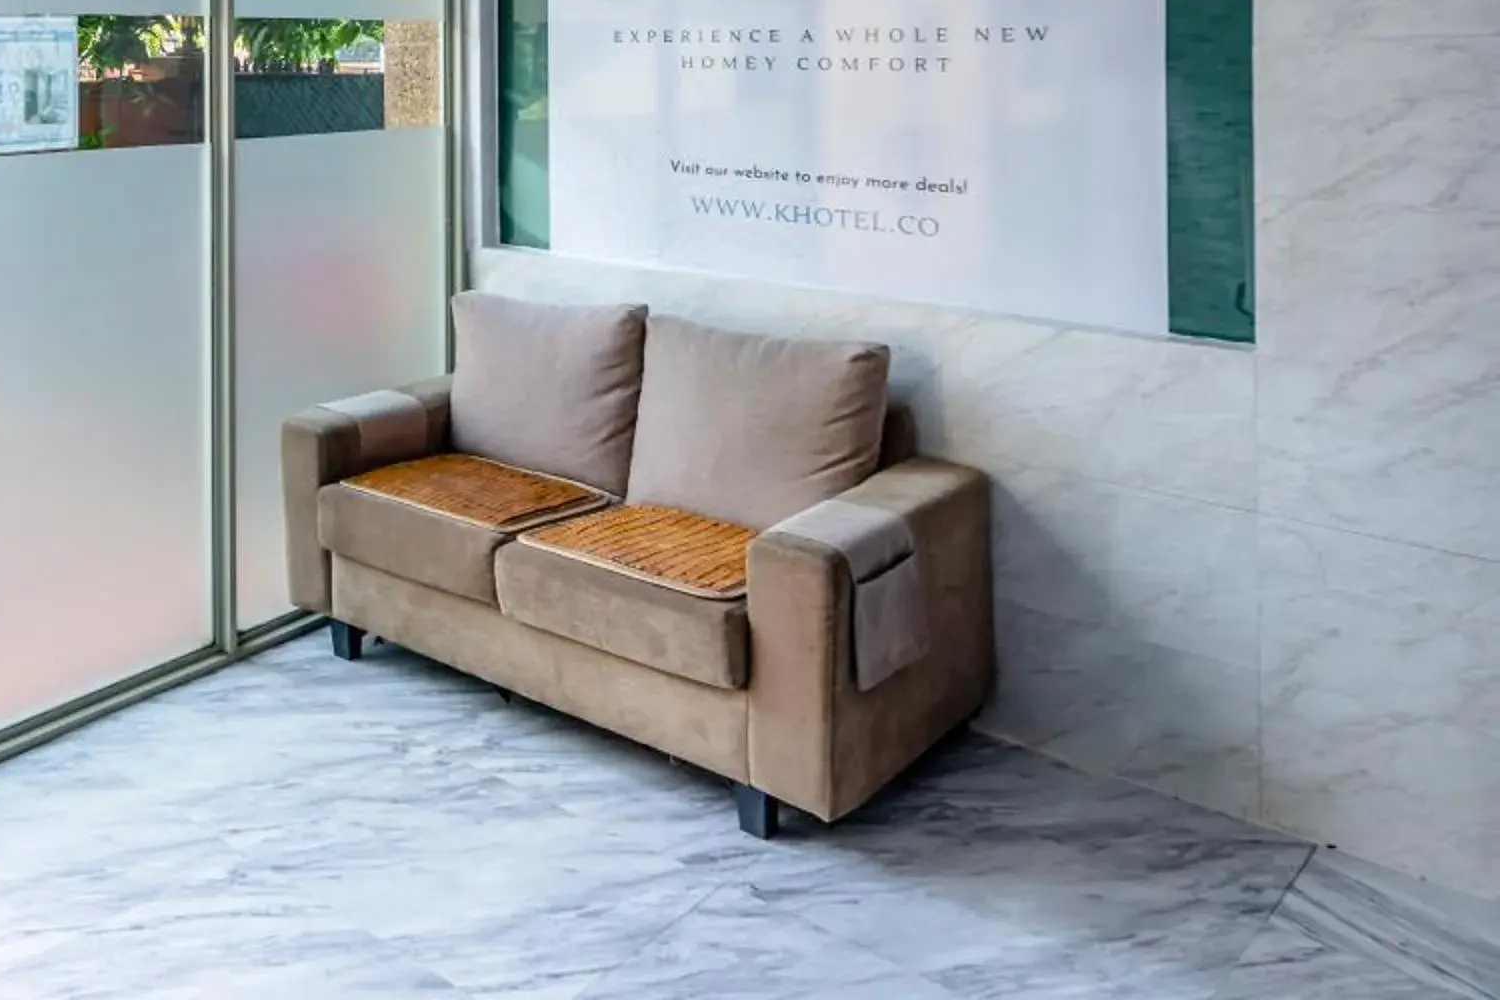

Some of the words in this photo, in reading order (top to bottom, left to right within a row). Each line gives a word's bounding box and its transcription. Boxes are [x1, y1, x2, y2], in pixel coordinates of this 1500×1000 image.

[613, 28, 783, 45] EXPERIENCE
[800, 29, 816, 44] A
[836, 26, 951, 44] WHOLE
[975, 26, 1051, 43] NEW
[680, 55, 777, 71] HOMEY
[797, 56, 952, 73] COMFORT
[670, 160, 701, 175] Visit
[705, 165, 729, 177] our
[733, 165, 790, 182] website
[795, 169, 812, 184] to
[816, 171, 860, 189] enjoy
[864, 177, 909, 191] more
[915, 177, 969, 195] deals!
[691, 196, 941, 238] WWW.KHOTEL.CO
